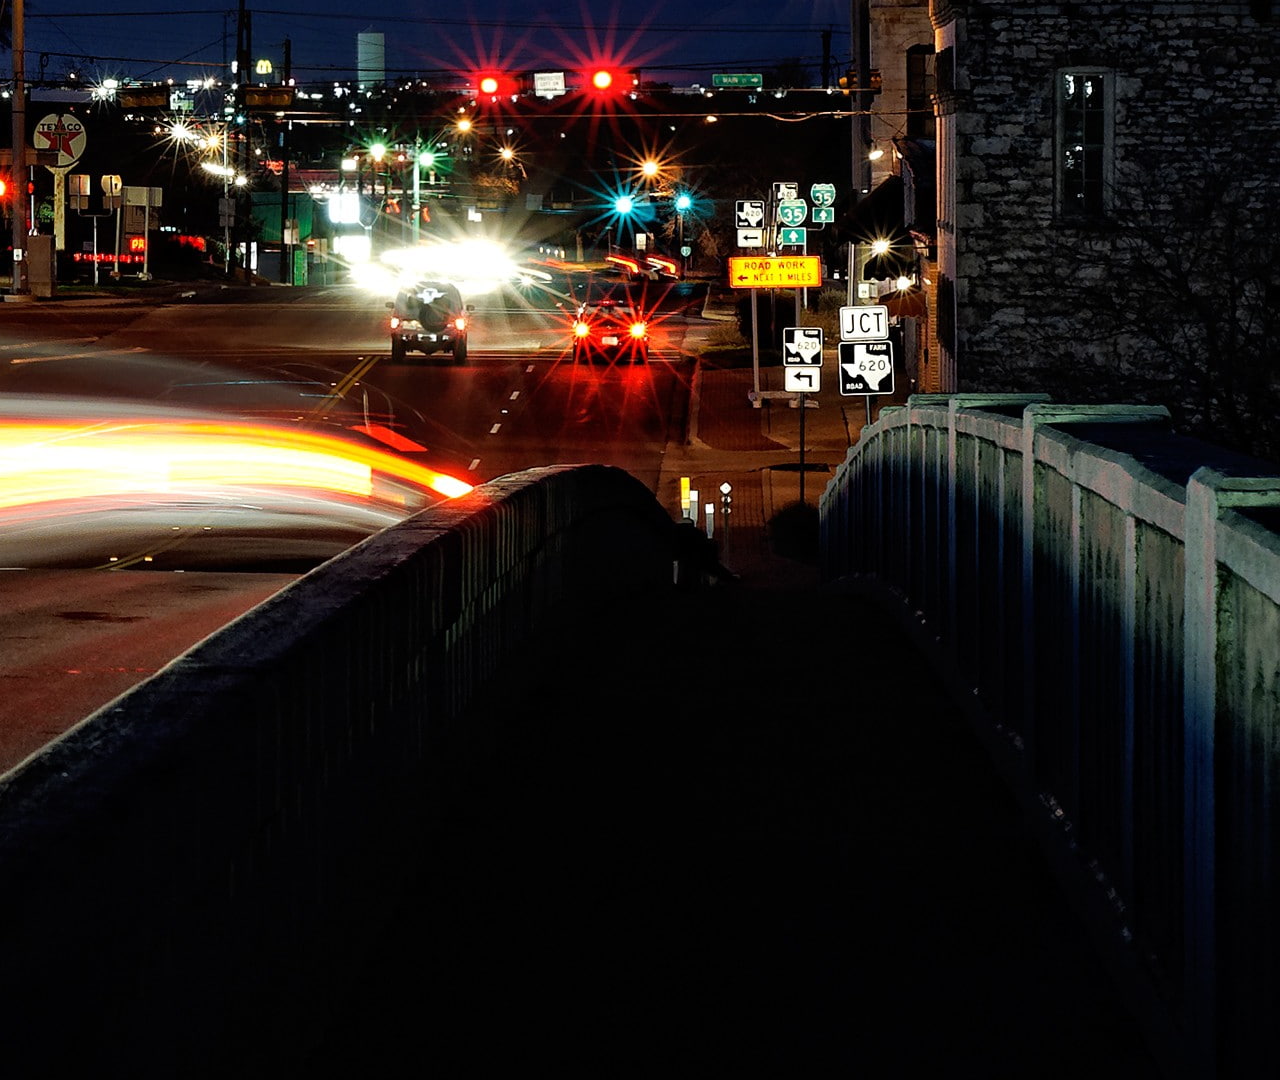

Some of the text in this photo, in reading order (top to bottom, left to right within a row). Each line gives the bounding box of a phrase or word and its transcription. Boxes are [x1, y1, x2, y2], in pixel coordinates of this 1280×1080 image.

[40, 123, 81, 131] TEXACO
[815, 192, 831, 204] 35
[783, 208, 803, 222] 35
[744, 261, 806, 270] ROAD WORK
[787, 273, 812, 281] MILES
[846, 313, 883, 334] JCT
[797, 341, 817, 350] 620
[859, 359, 886, 371] 620
